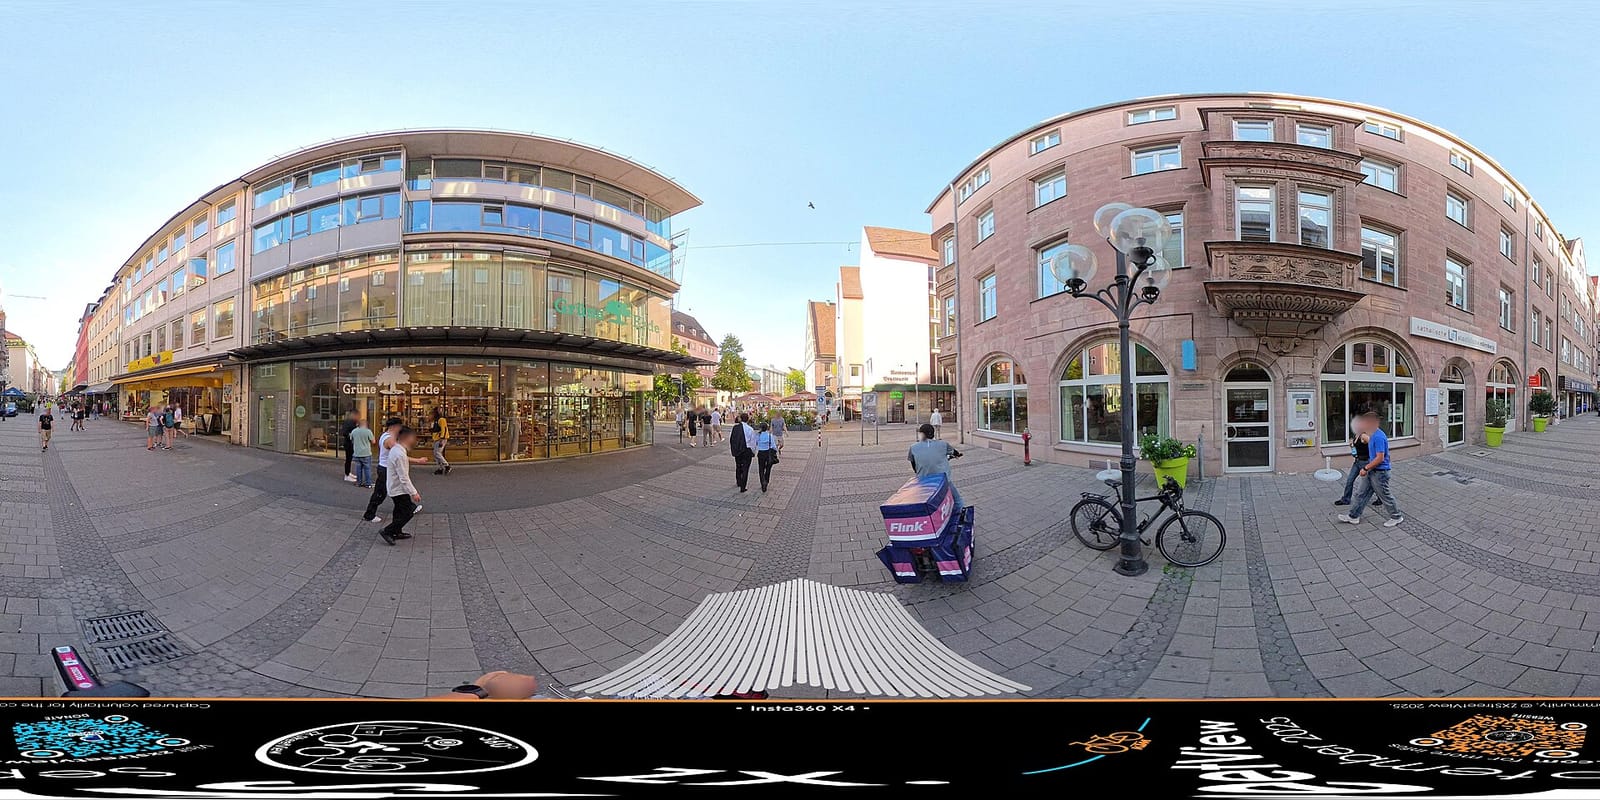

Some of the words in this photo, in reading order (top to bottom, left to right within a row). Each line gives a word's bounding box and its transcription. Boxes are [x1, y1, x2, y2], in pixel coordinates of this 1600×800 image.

[342, 383, 376, 395] Grüne
[410, 382, 440, 395] Erde
[890, 521, 928, 533] Flink
